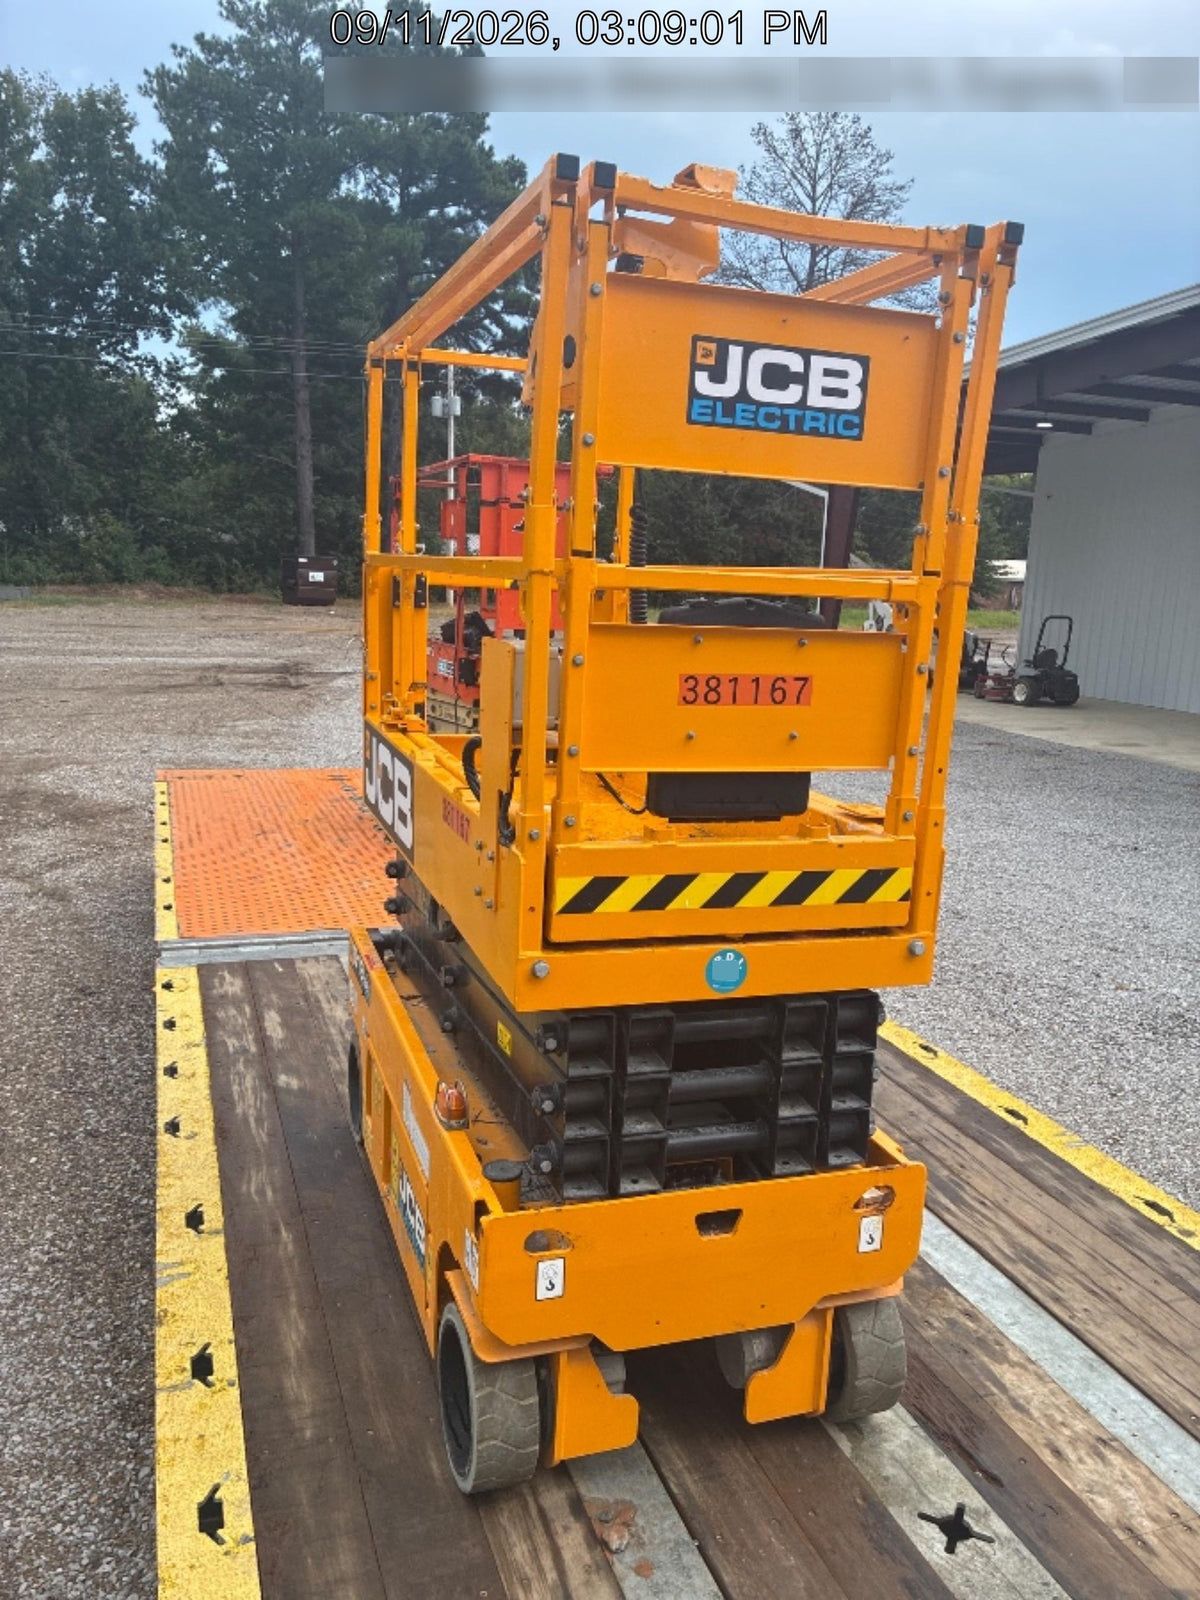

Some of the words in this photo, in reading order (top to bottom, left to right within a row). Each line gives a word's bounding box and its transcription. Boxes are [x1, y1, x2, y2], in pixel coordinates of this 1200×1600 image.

[694, 344, 863, 410] JCB
[690, 398, 860, 436] ELECTRIC
[682, 675, 809, 705] 381167
[365, 735, 413, 850] JCB
